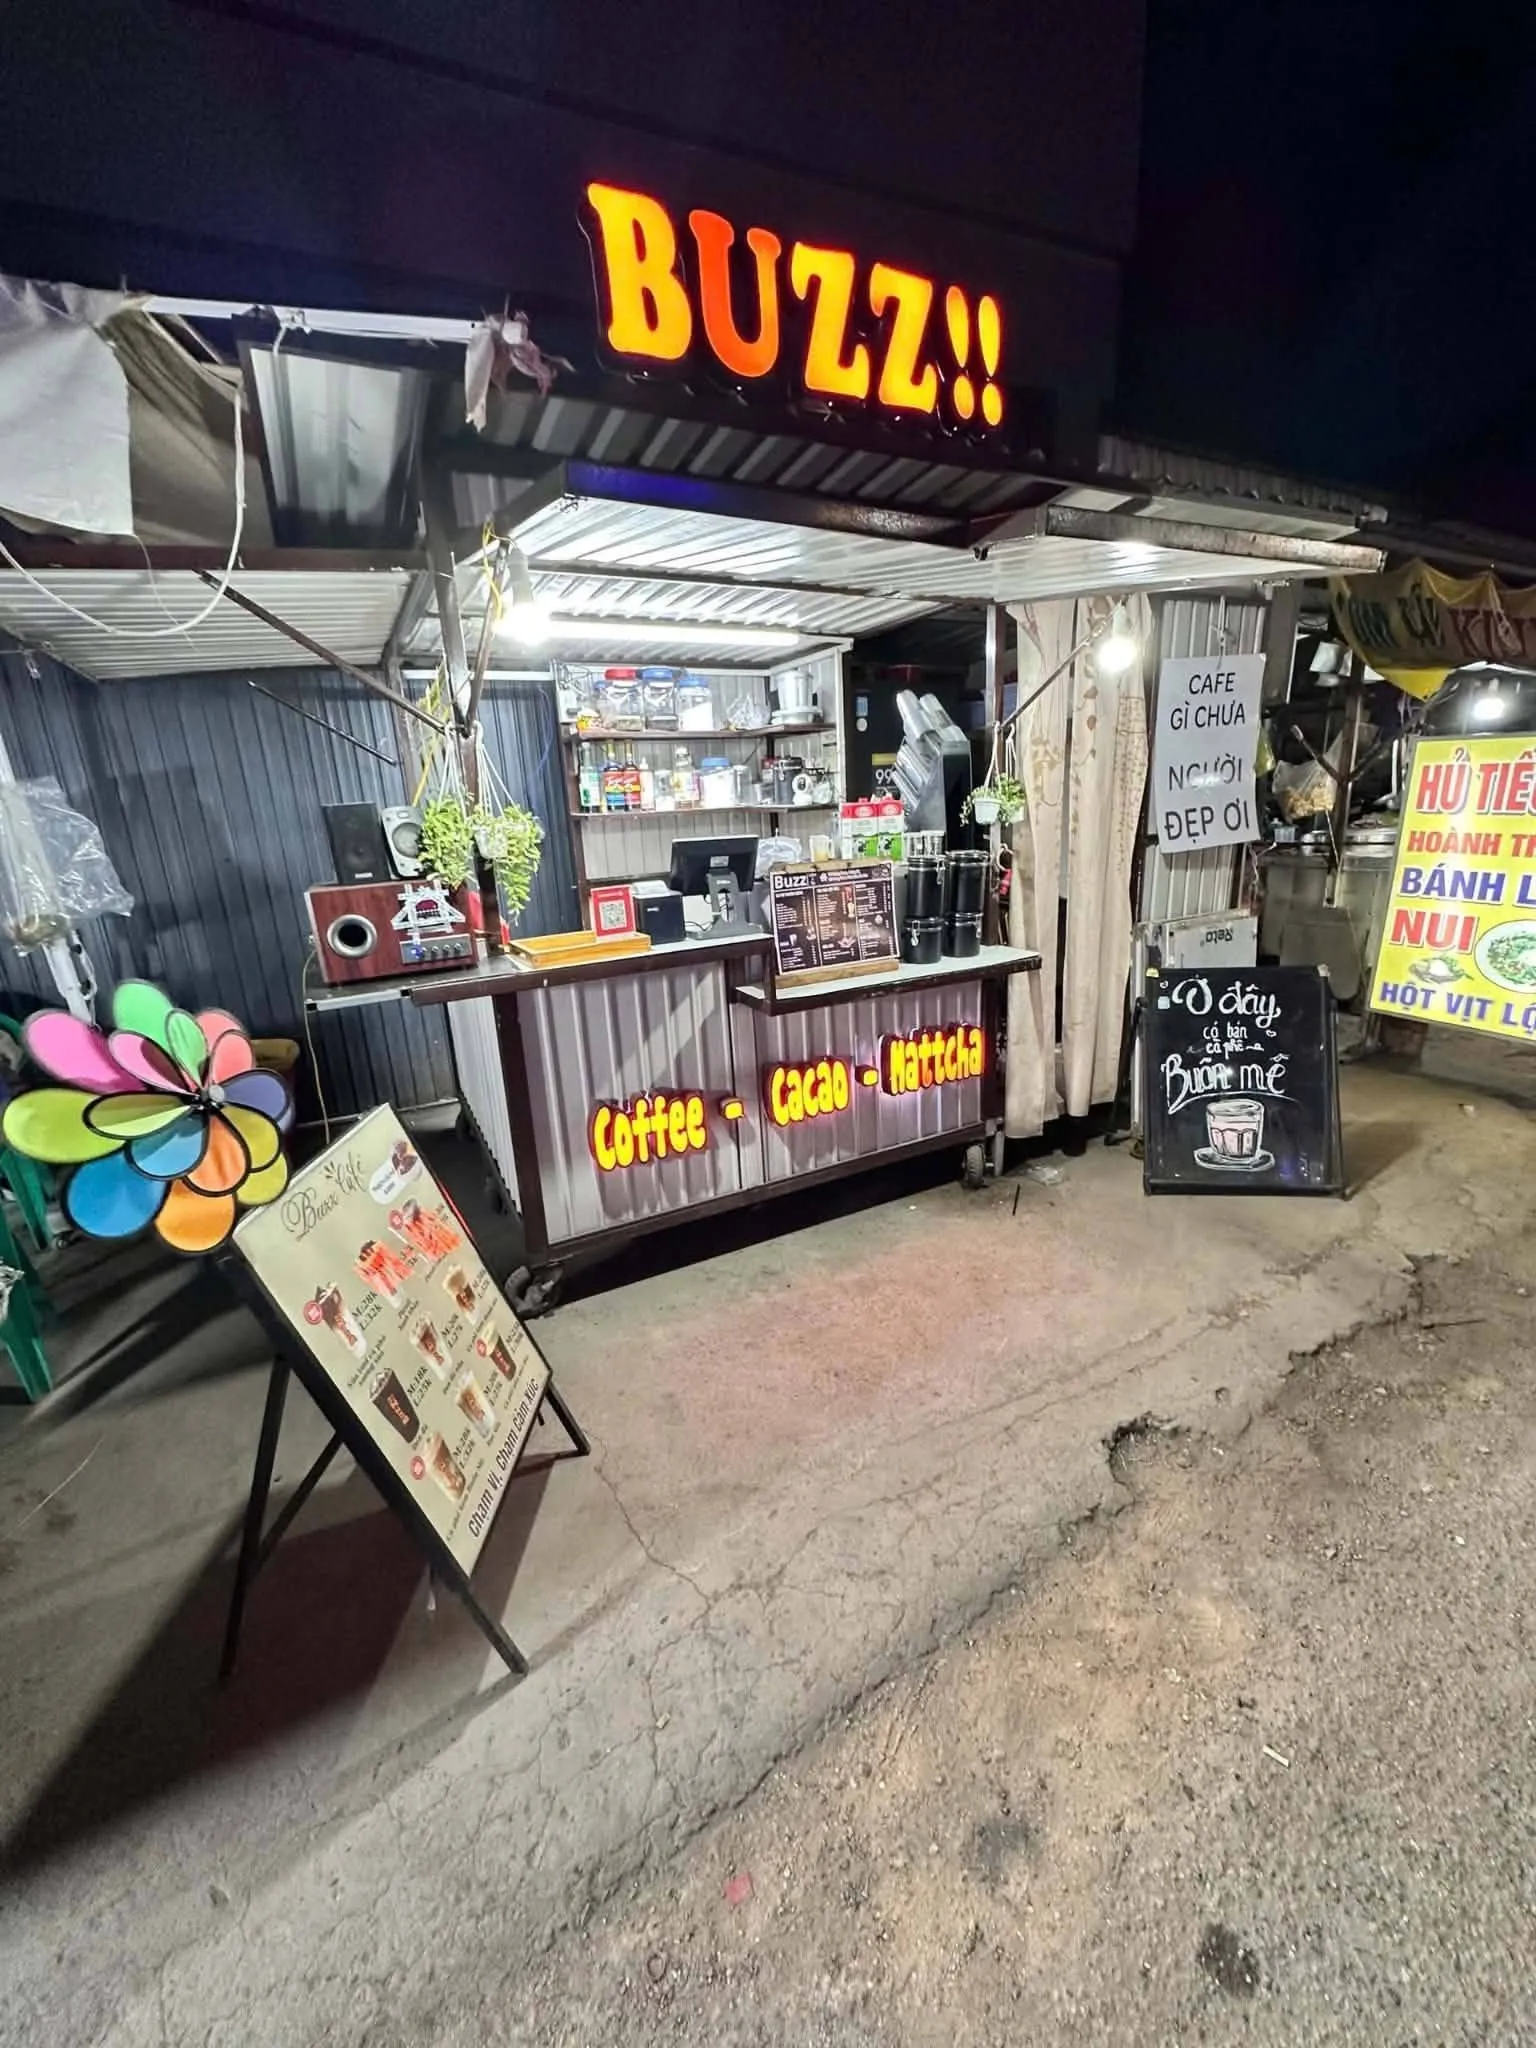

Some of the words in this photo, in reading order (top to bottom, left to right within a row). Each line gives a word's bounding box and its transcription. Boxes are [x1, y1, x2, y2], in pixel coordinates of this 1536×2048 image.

[588, 183, 1003, 426] BUZZ!!
[1188, 672, 1236, 695] CAFE
[1170, 701, 1190, 731] GÌ
[1194, 700, 1246, 728] CHƯA
[1416, 747, 1469, 813] HỦ
[1164, 806, 1215, 844] ĐẸP
[1223, 797, 1250, 831] ƠI
[1408, 826, 1503, 856] HOÀNH
[1399, 863, 1506, 902] BÁNH
[1391, 909, 1476, 951] NUI
[1219, 980, 1281, 1029] đây
[1379, 982, 1436, 1010] HỘT
[1446, 992, 1494, 1021] VỊT
[1203, 1020, 1219, 1039] có
[1227, 1020, 1248, 1039] bán
[593, 1094, 709, 1172] Coffee
[769, 1057, 850, 1128] Cacao
[889, 1026, 984, 1097] Mattcha
[467, 1484, 495, 1543] Chạm
[494, 1423, 520, 1476] Chạm
